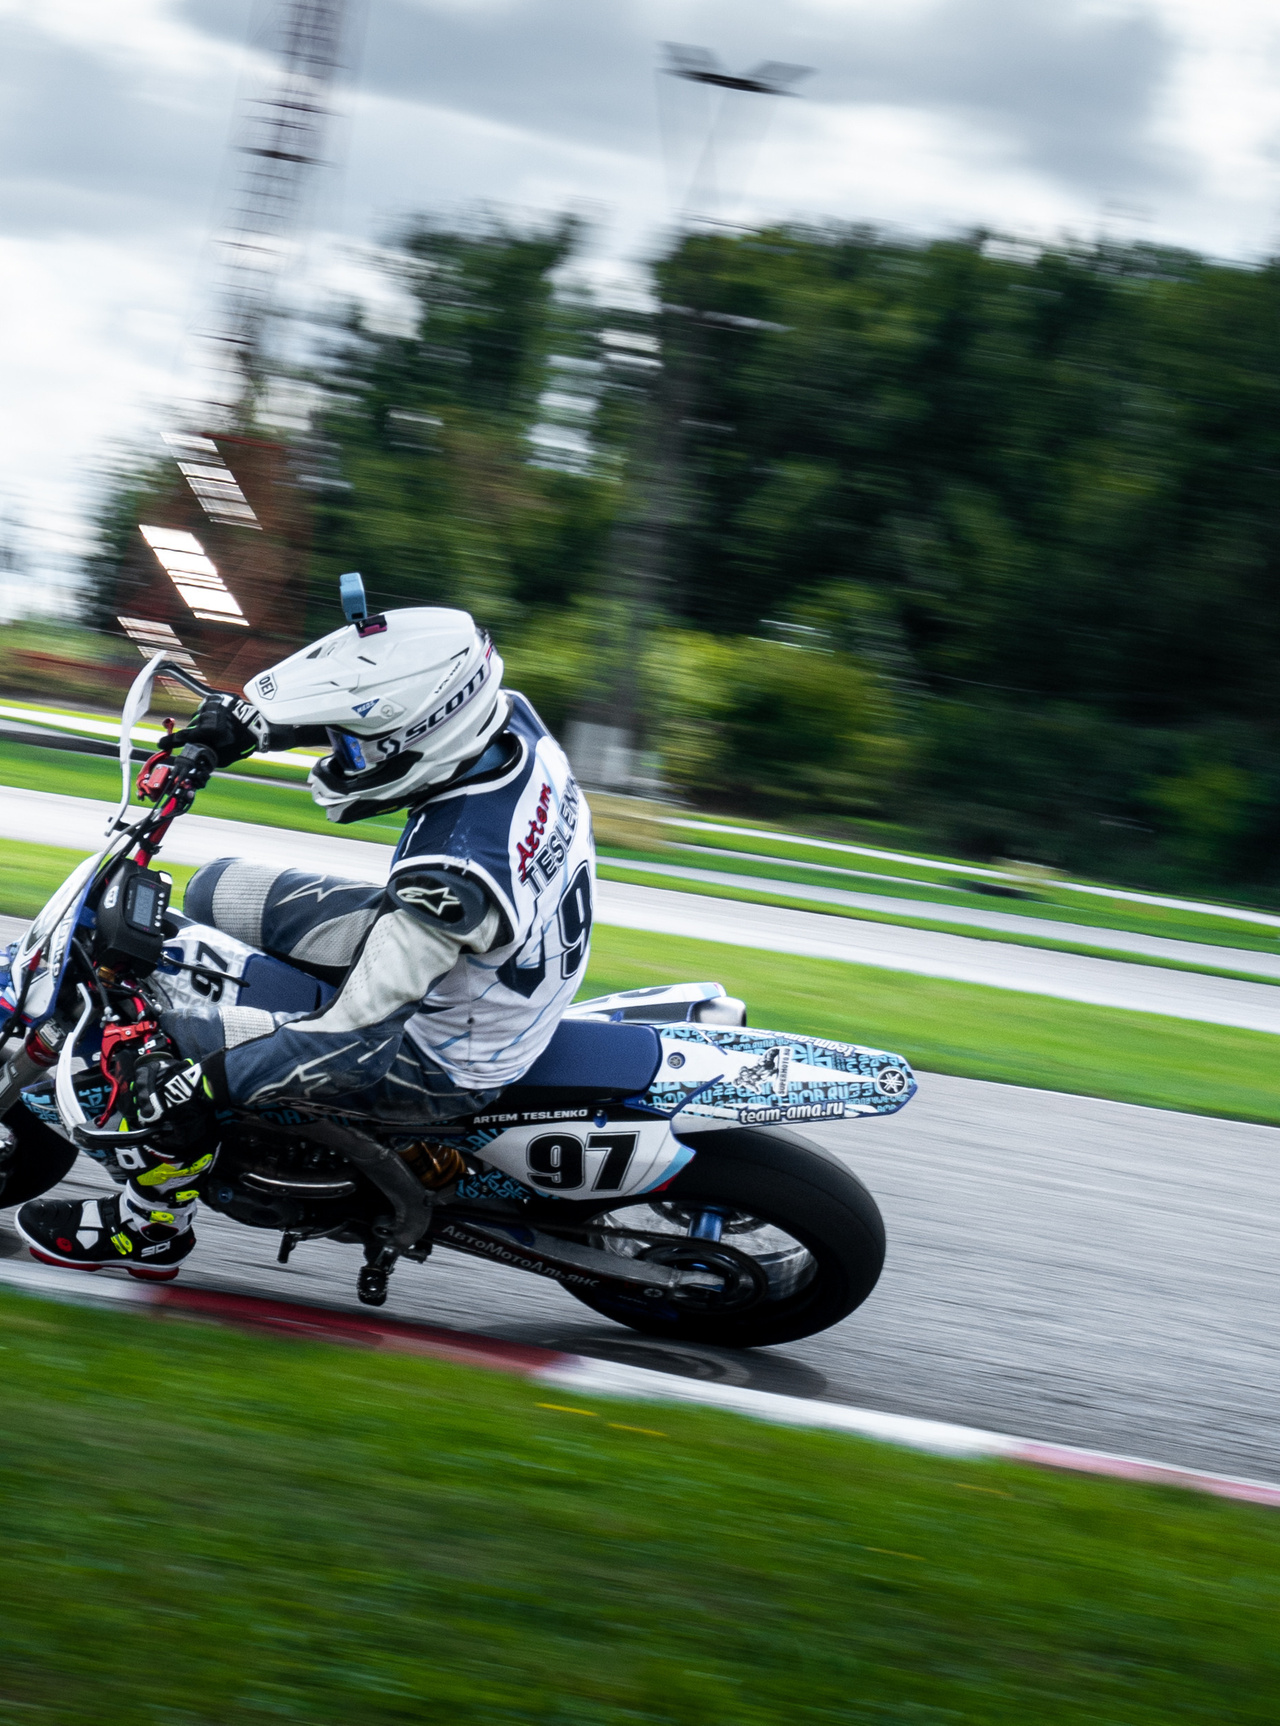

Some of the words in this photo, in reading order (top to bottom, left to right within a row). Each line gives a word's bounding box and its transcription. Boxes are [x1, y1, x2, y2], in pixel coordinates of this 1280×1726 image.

[258, 676, 275, 696] OEI
[404, 664, 485, 743] SCOTT
[519, 776, 579, 897] TESLEN
[473, 1112, 518, 1125] ARTEM
[521, 1108, 588, 1121] TESLENKO
[740, 1101, 844, 1124] team-ama.ru
[526, 1130, 641, 1192] 97
